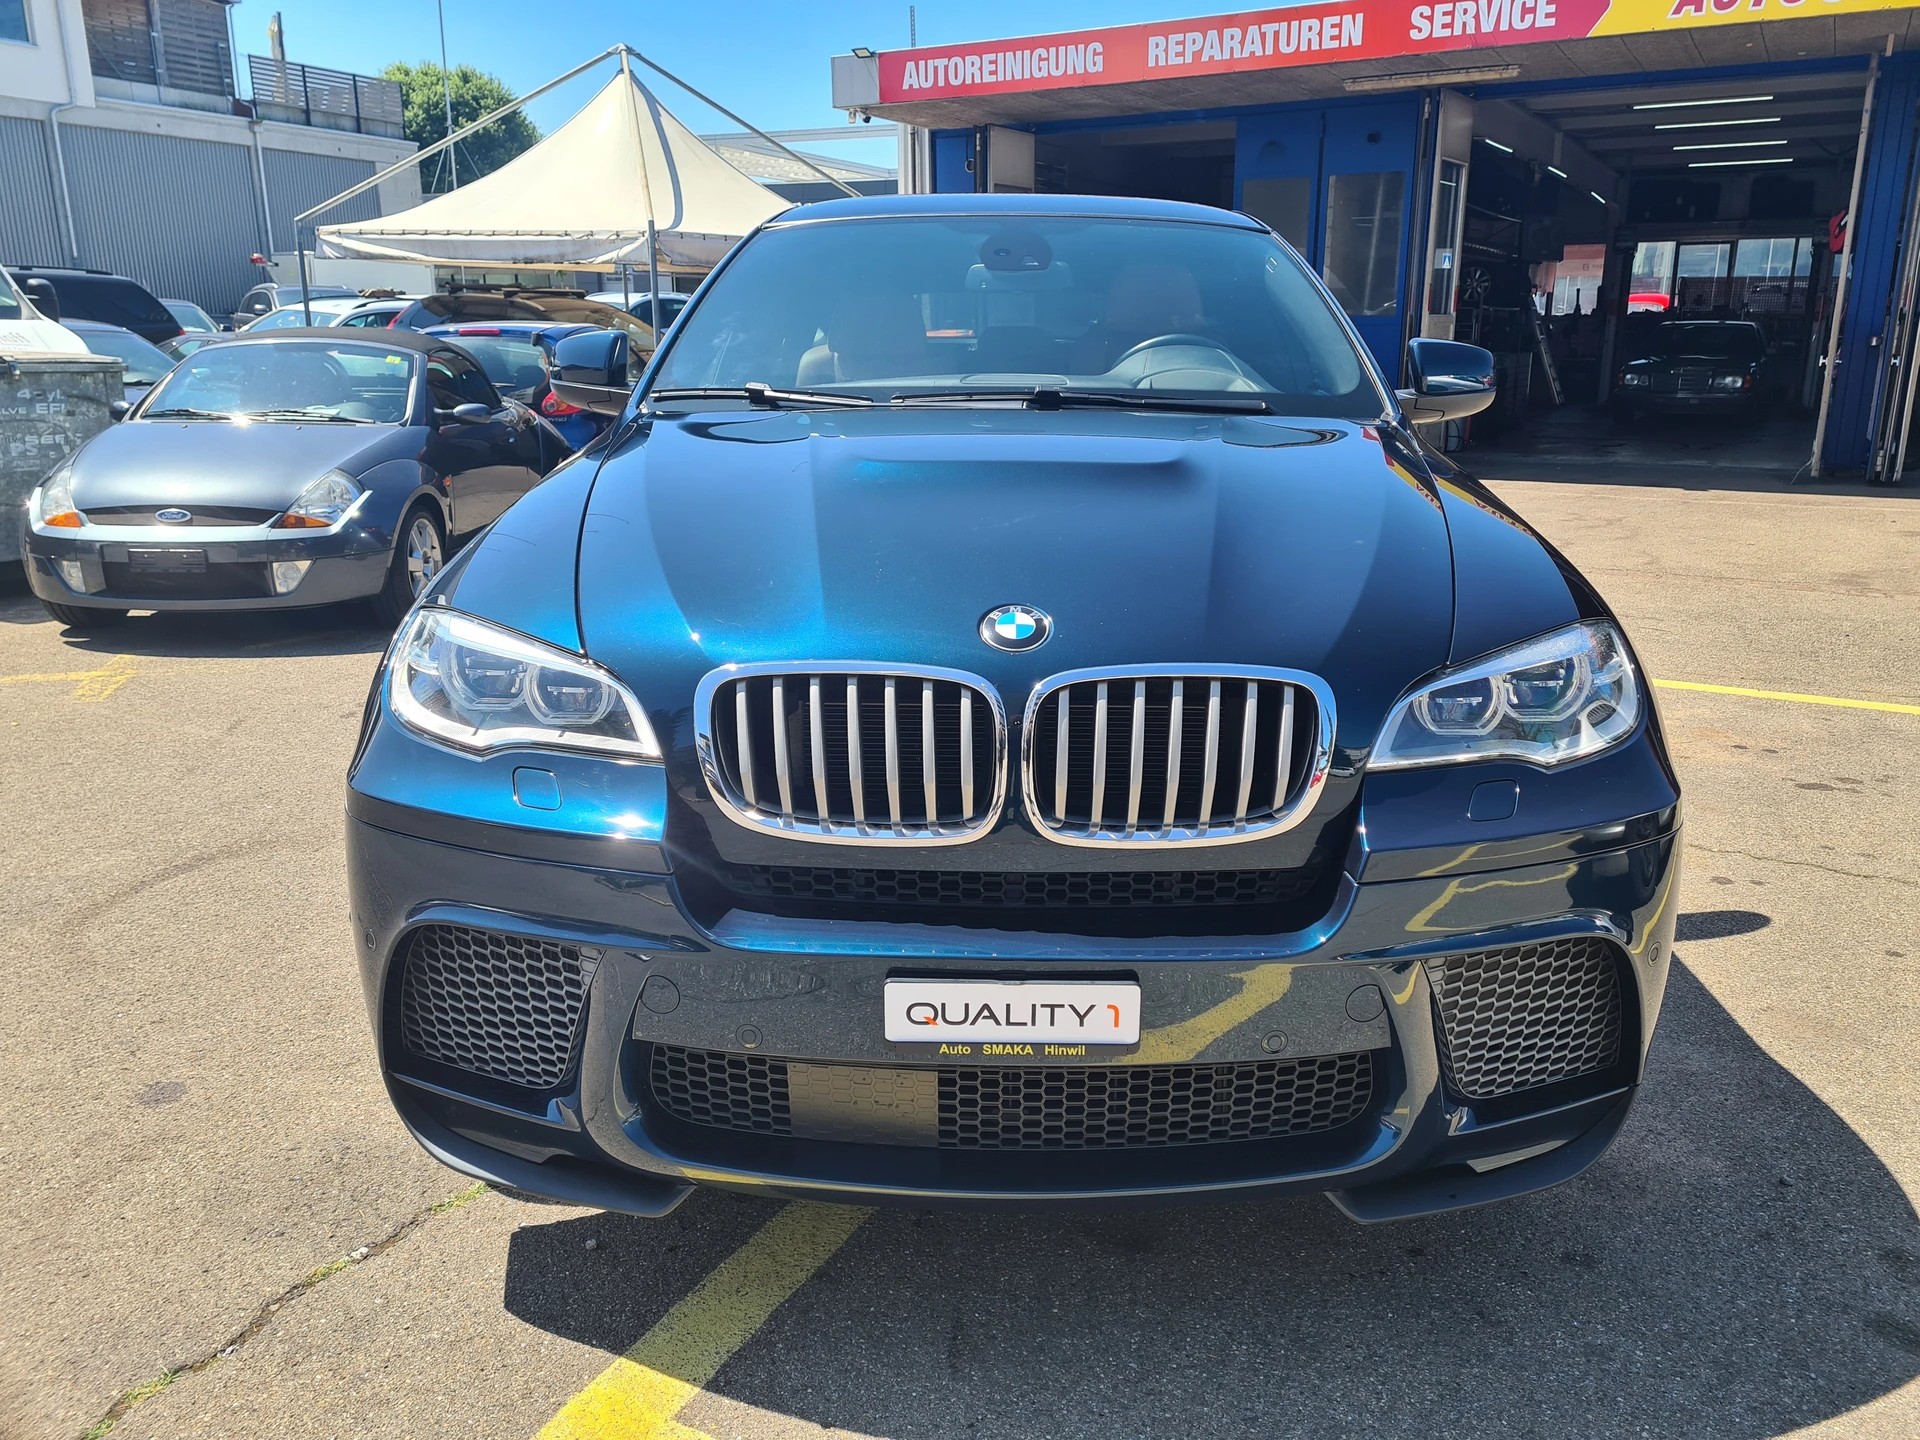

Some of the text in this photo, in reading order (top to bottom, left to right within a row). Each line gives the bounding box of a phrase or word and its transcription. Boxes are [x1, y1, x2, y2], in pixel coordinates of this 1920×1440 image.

[902, 0, 1557, 90] AUTOREINIGUNG REPARATUREN SERVICE
[0, 406, 27, 415] LVE
[989, 606, 1042, 620] BMW
[906, 1002, 1097, 1028] QUALITY
[939, 1043, 1086, 1056] Auto SMAKA Hinwil
